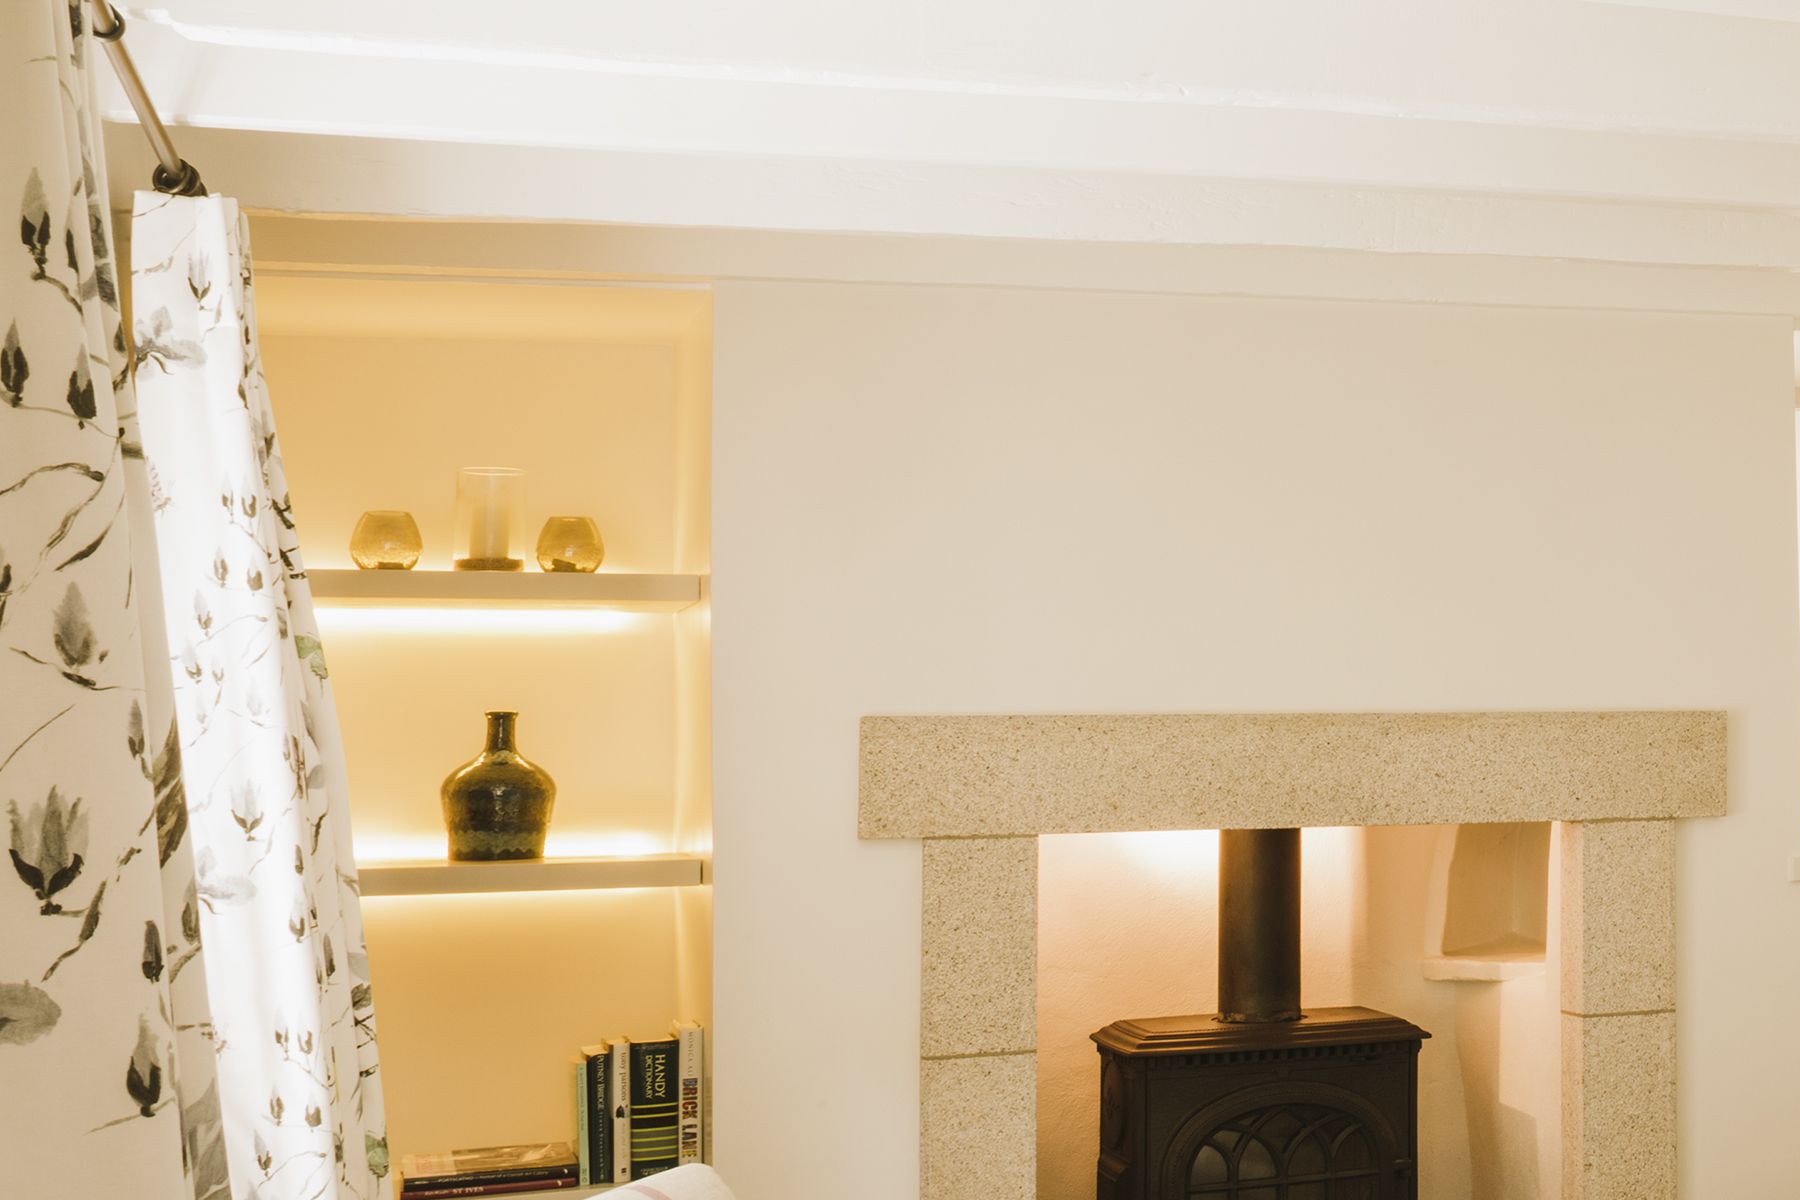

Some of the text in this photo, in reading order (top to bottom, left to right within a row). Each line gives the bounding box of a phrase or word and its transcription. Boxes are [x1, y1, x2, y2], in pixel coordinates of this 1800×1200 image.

[597, 1084, 605, 1110] BRIDGE
[618, 1072, 627, 1102] parsons
[645, 1055, 653, 1100] DICTIONARY
[655, 1054, 667, 1098] HANDY
[682, 1078, 698, 1158] BRICK LANE
